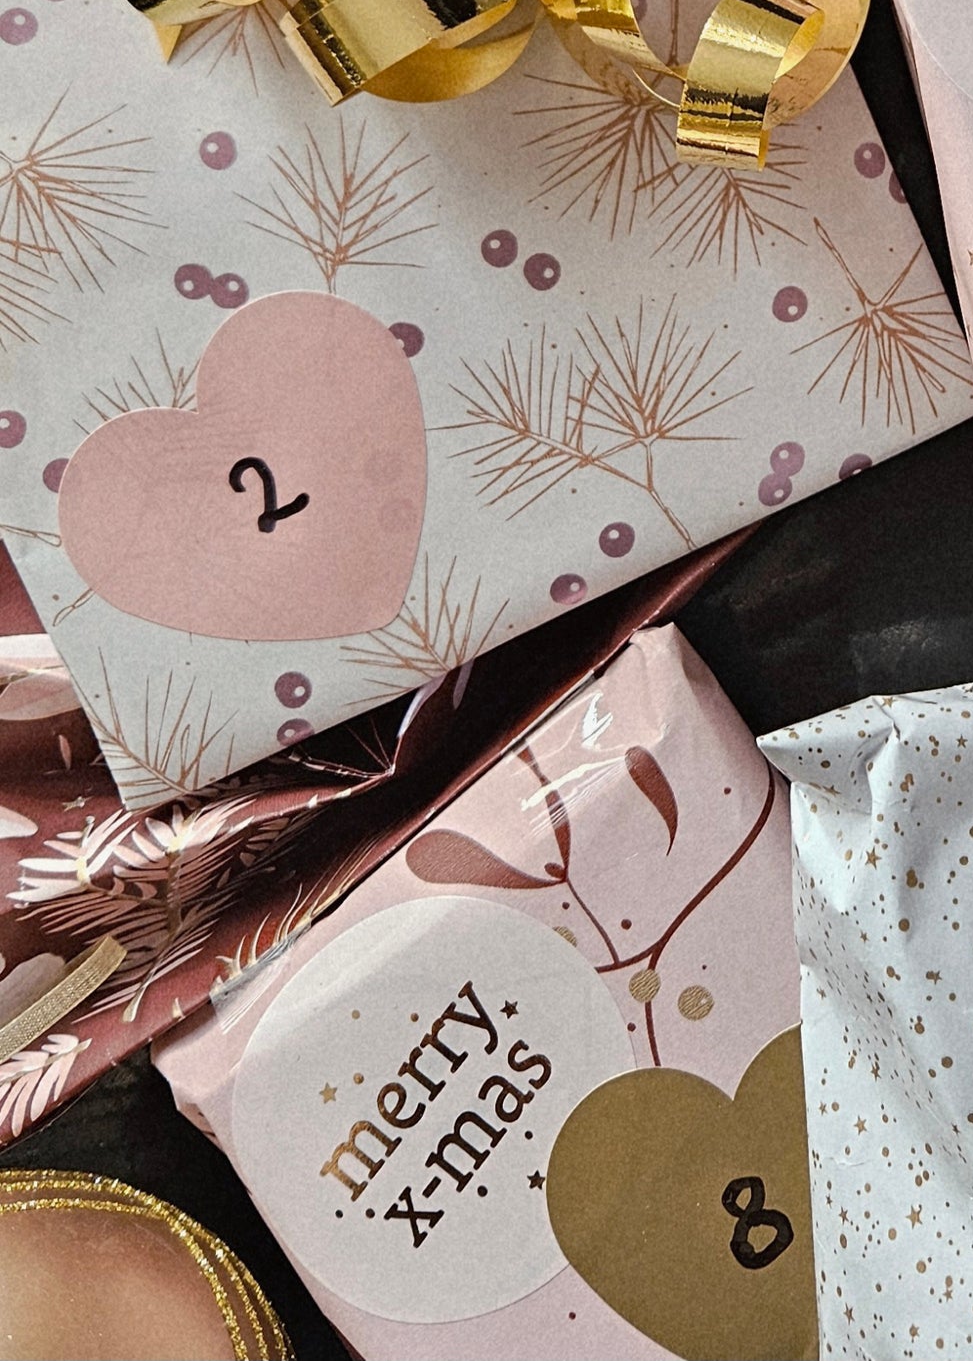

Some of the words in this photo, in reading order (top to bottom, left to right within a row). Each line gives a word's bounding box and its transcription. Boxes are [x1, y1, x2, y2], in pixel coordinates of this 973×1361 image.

[228, 457, 310, 533] 2
[320, 981, 499, 1201] merry
[384, 1039, 553, 1248] x-mas
[721, 1176, 794, 1269] 8
